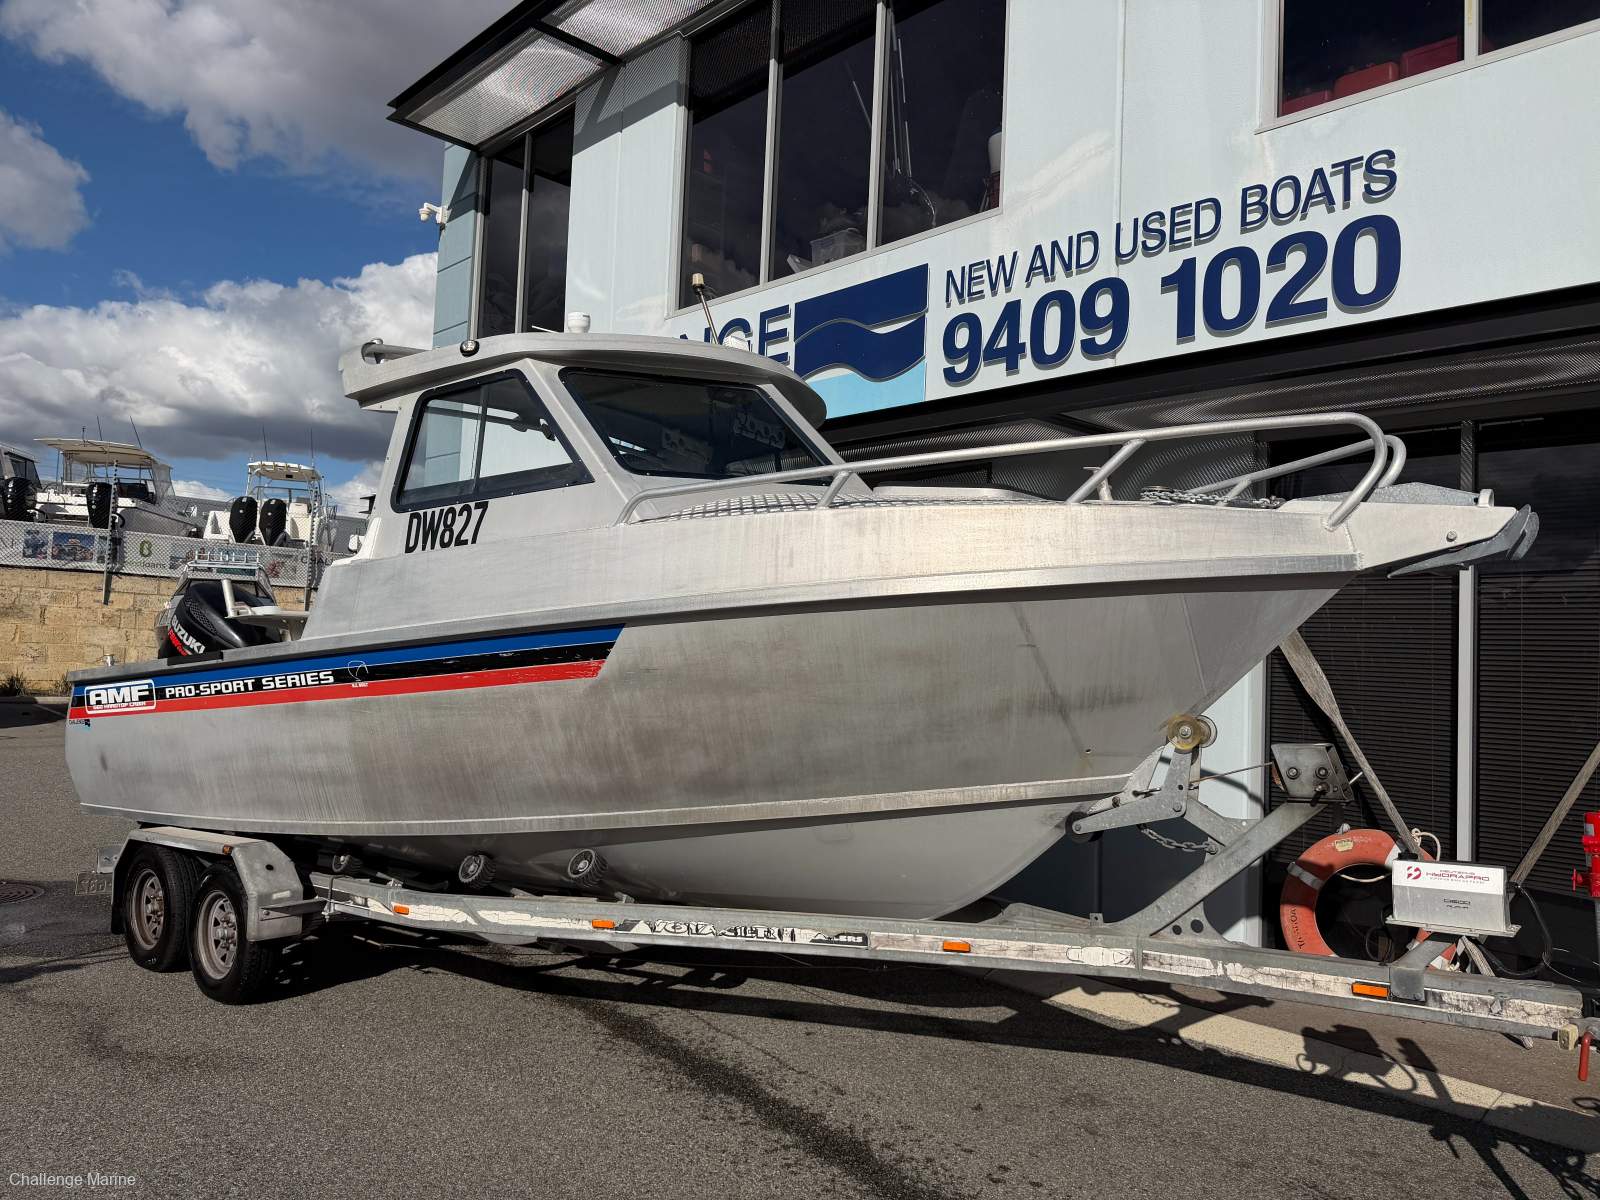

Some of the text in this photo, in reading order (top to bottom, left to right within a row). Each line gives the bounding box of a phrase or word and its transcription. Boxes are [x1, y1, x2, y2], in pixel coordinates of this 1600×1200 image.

[945, 149, 1398, 305] NEW AND USED BOATS
[942, 214, 1401, 386] 9409 1020
[405, 502, 489, 554] DW827
[171, 614, 206, 654] SUZUKI
[89, 684, 150, 706] AMF
[165, 670, 334, 699] PRO-SPORT SERIES
